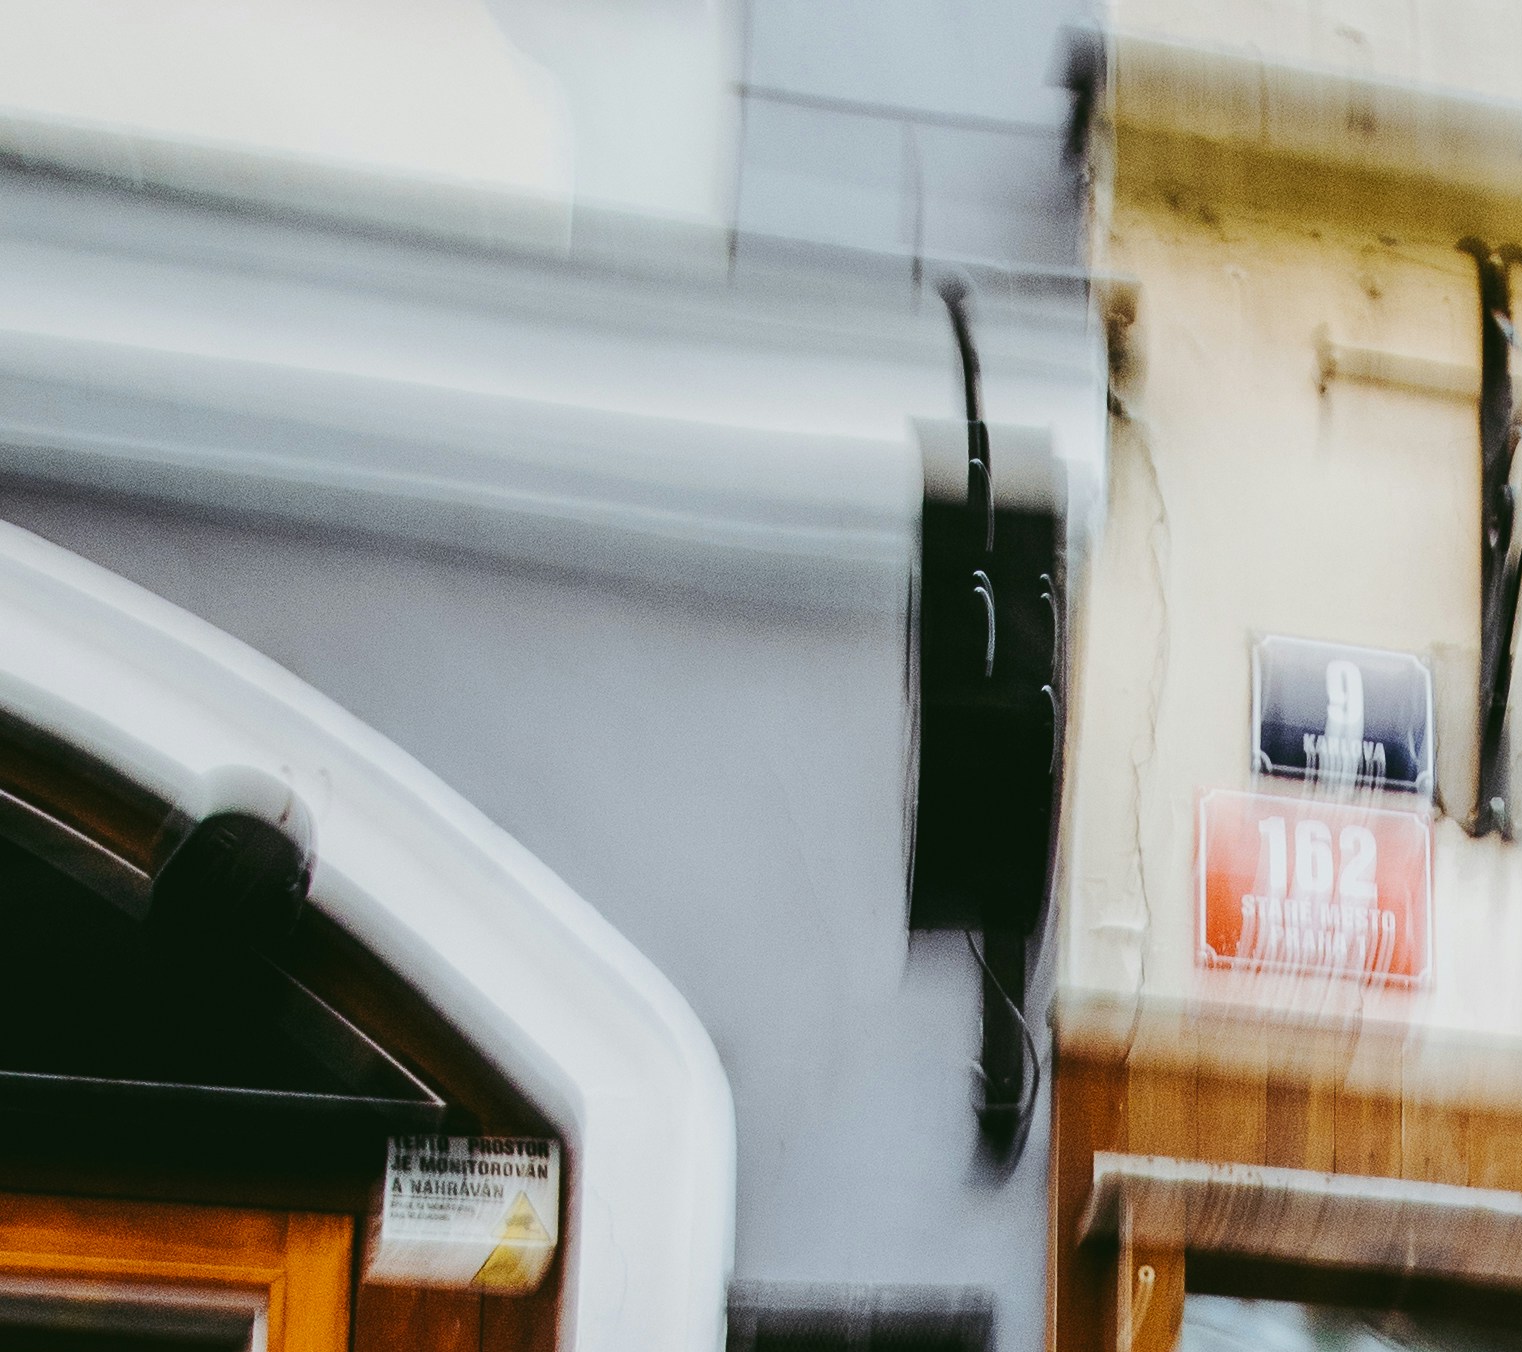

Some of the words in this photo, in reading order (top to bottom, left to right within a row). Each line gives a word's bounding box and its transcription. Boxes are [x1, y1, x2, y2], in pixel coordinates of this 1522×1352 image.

[1326, 660, 1364, 726] 9
[1258, 816, 1378, 899] 162
[468, 1138, 549, 1157] PROSTOR
